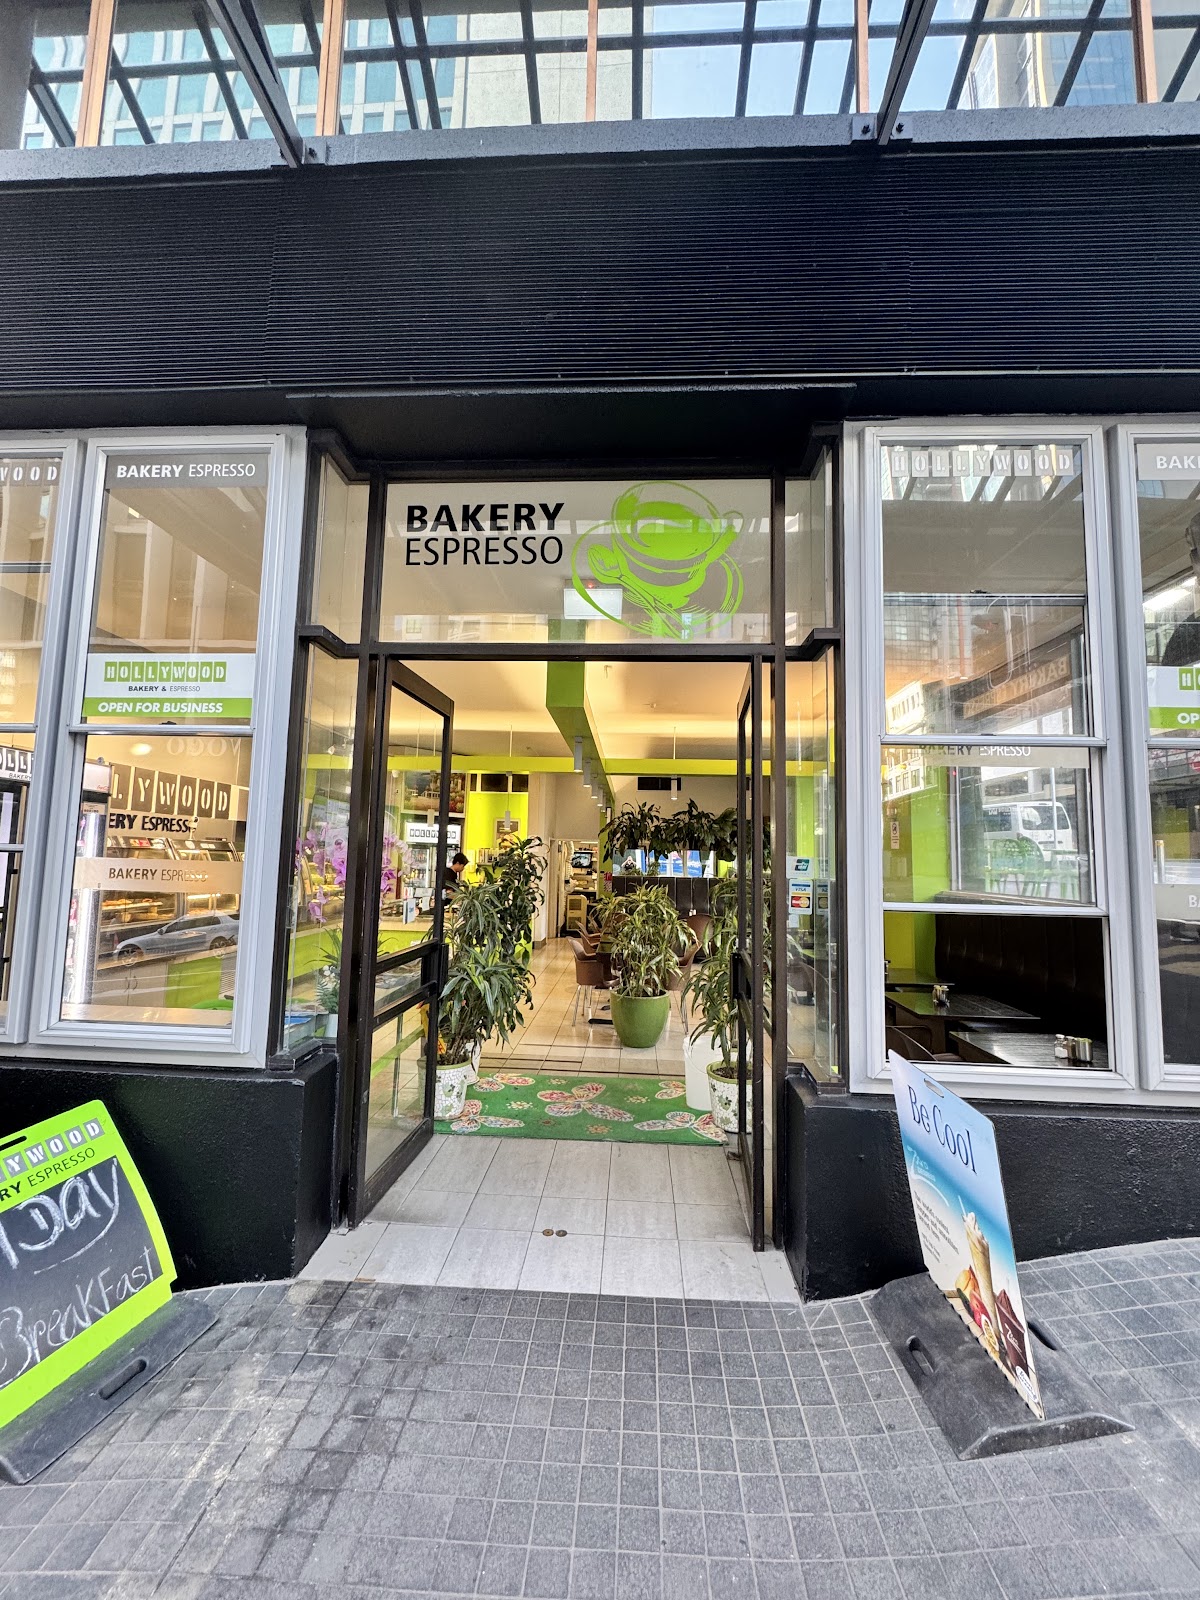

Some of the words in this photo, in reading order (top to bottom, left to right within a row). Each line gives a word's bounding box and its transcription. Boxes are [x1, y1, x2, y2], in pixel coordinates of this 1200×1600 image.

[116, 464, 184, 478] BAKERY
[188, 463, 256, 477] ESPRESSO
[893, 453, 1071, 472] HOLLYWOOD
[406, 502, 565, 533] BAKERY
[405, 536, 563, 566] ESPRESSO
[105, 664, 226, 680] HOLLYWOOD
[98, 702, 134, 713] OPEN
[135, 702, 160, 713] FOR
[162, 702, 223, 713] BUSINESS
[141, 816, 197, 833] ESPRESS
[108, 867, 158, 881] BAKERY
[161, 869, 209, 882] ESPRESSO
[907, 1084, 931, 1134] Be
[932, 1104, 978, 1176] Cool
[0, 1121, 101, 1180] YWOOD
[27, 1147, 96, 1188] ESPRESSO
